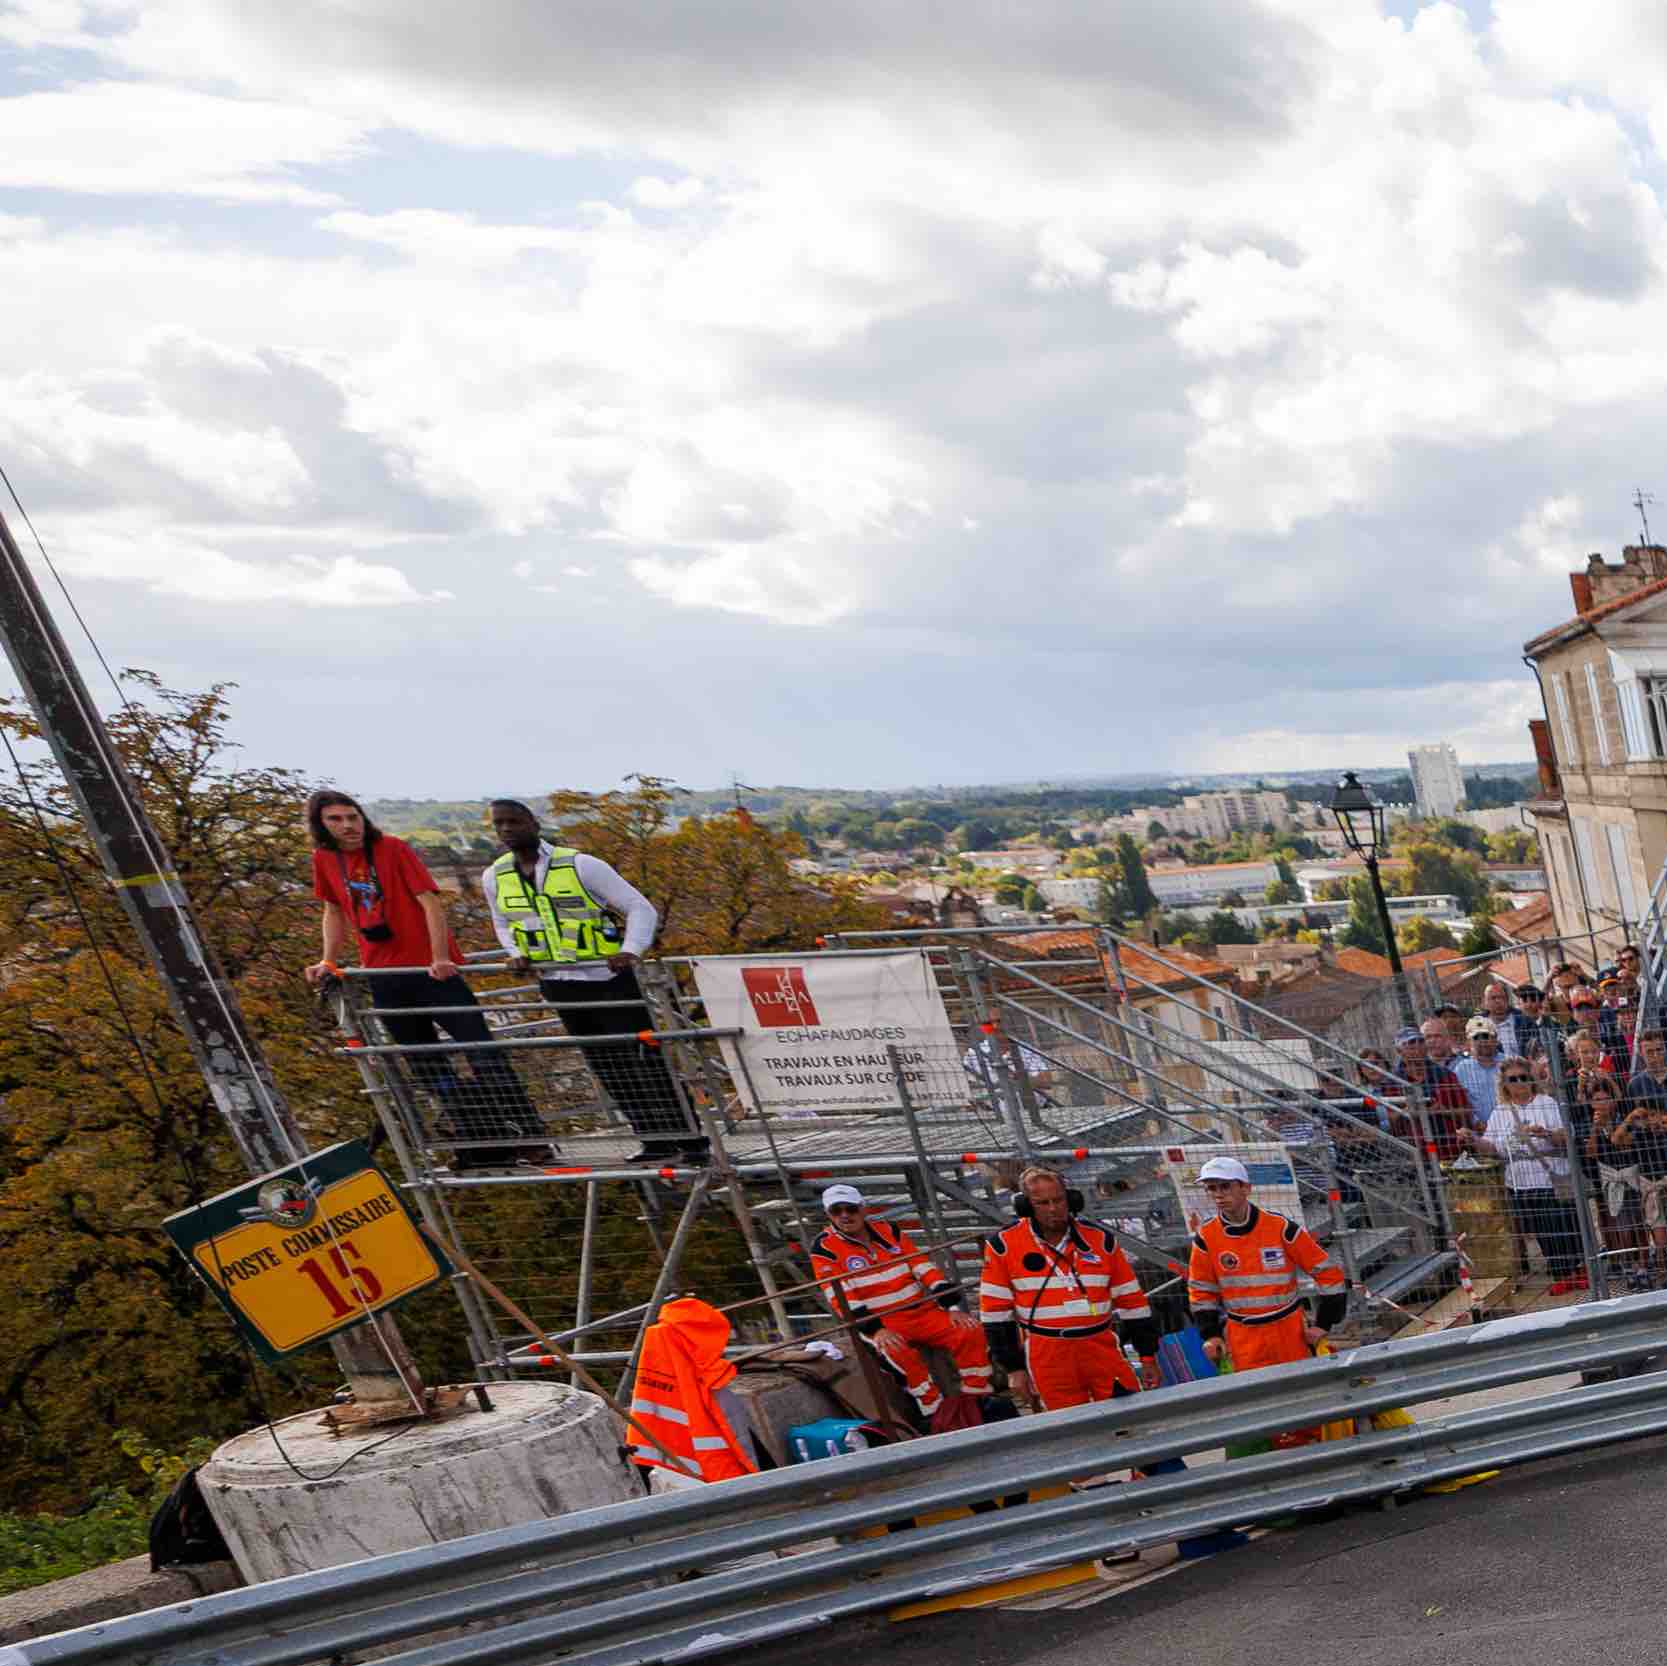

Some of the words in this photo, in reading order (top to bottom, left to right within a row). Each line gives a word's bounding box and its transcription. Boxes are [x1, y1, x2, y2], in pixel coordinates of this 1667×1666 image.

[776, 1026, 907, 1043] ECHAFAUDAGES
[764, 1055, 831, 1070] TRAVAUX
[834, 1055, 853, 1067] EN
[857, 1052, 925, 1067] HAUEUR
[776, 1072, 844, 1087] TRAVAUX
[847, 1072, 874, 1085] SUR
[877, 1071, 927, 1084] CODE
[223, 1246, 283, 1286] POSTE
[281, 1192, 397, 1258] COMMISSAIRE
[296, 1240, 384, 1319] 15
